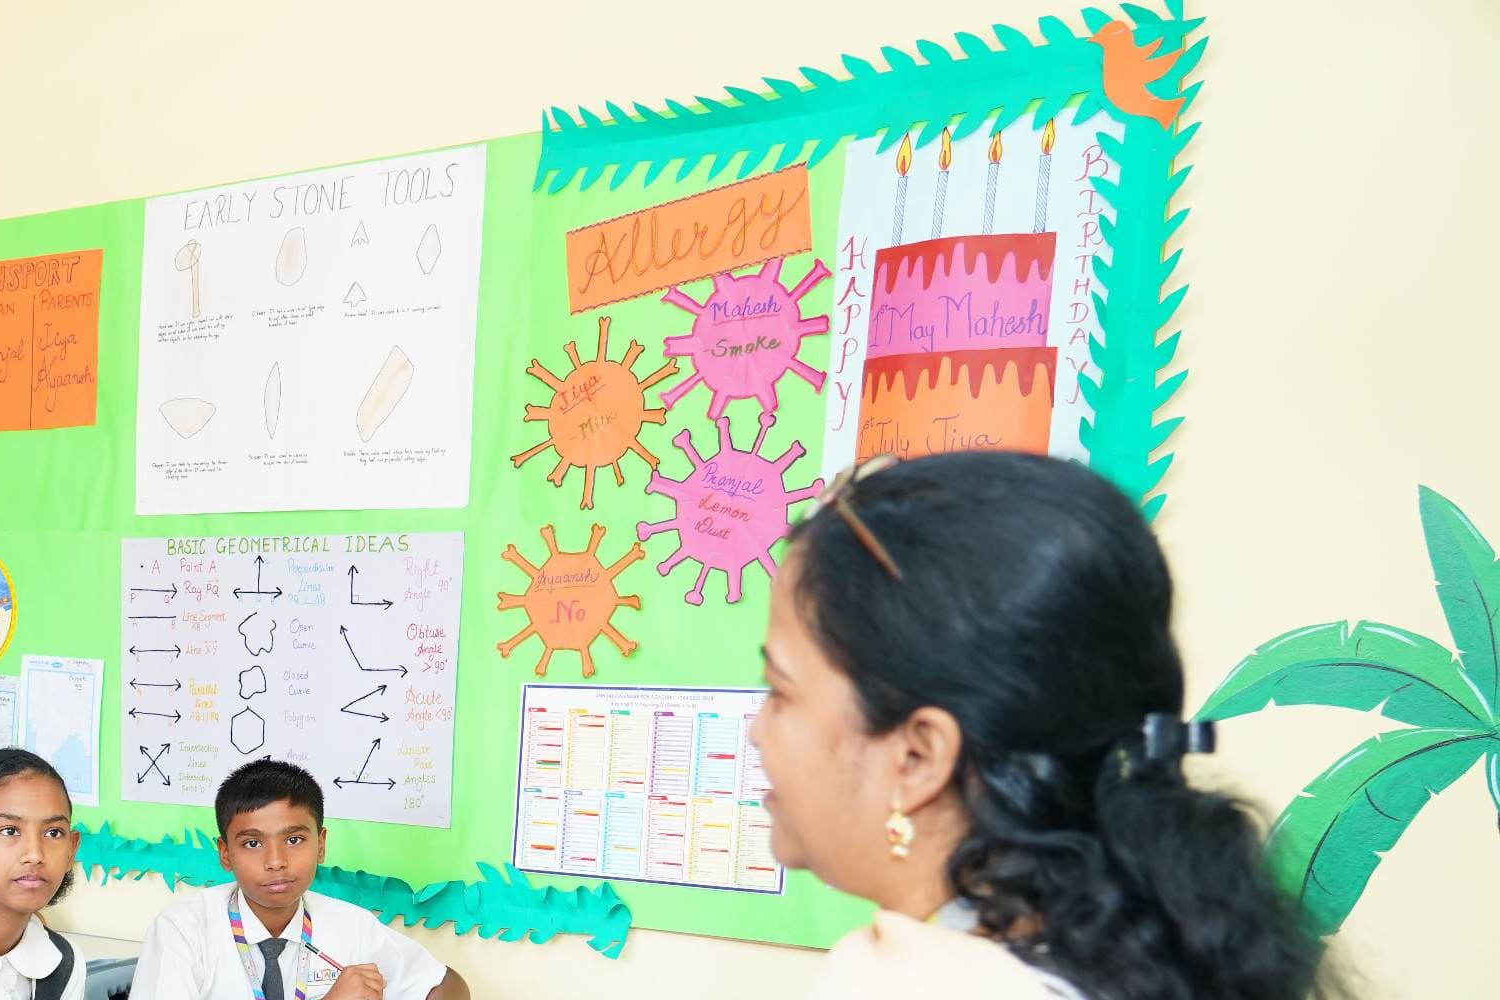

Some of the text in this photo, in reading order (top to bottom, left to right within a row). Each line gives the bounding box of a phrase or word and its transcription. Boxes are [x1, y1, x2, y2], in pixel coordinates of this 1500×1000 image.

[184, 164, 459, 231] EARLY STONE TOOLS
[578, 187, 806, 294] Allergy
[40, 289, 93, 311] PARENTS
[710, 297, 782, 321] Mahesh
[938, 292, 1048, 339] Mahesh
[40, 322, 78, 361] Jiya
[833, 234, 869, 432] HAPPY
[558, 374, 601, 412] Jiya
[703, 462, 765, 498] Pranjal
[698, 497, 751, 523] Lemon
[167, 534, 410, 556] BASIC GEOMETRICAL IDEAS
[694, 518, 732, 541] Dust
[550, 600, 586, 624] No
[406, 623, 446, 641] Obtuse
